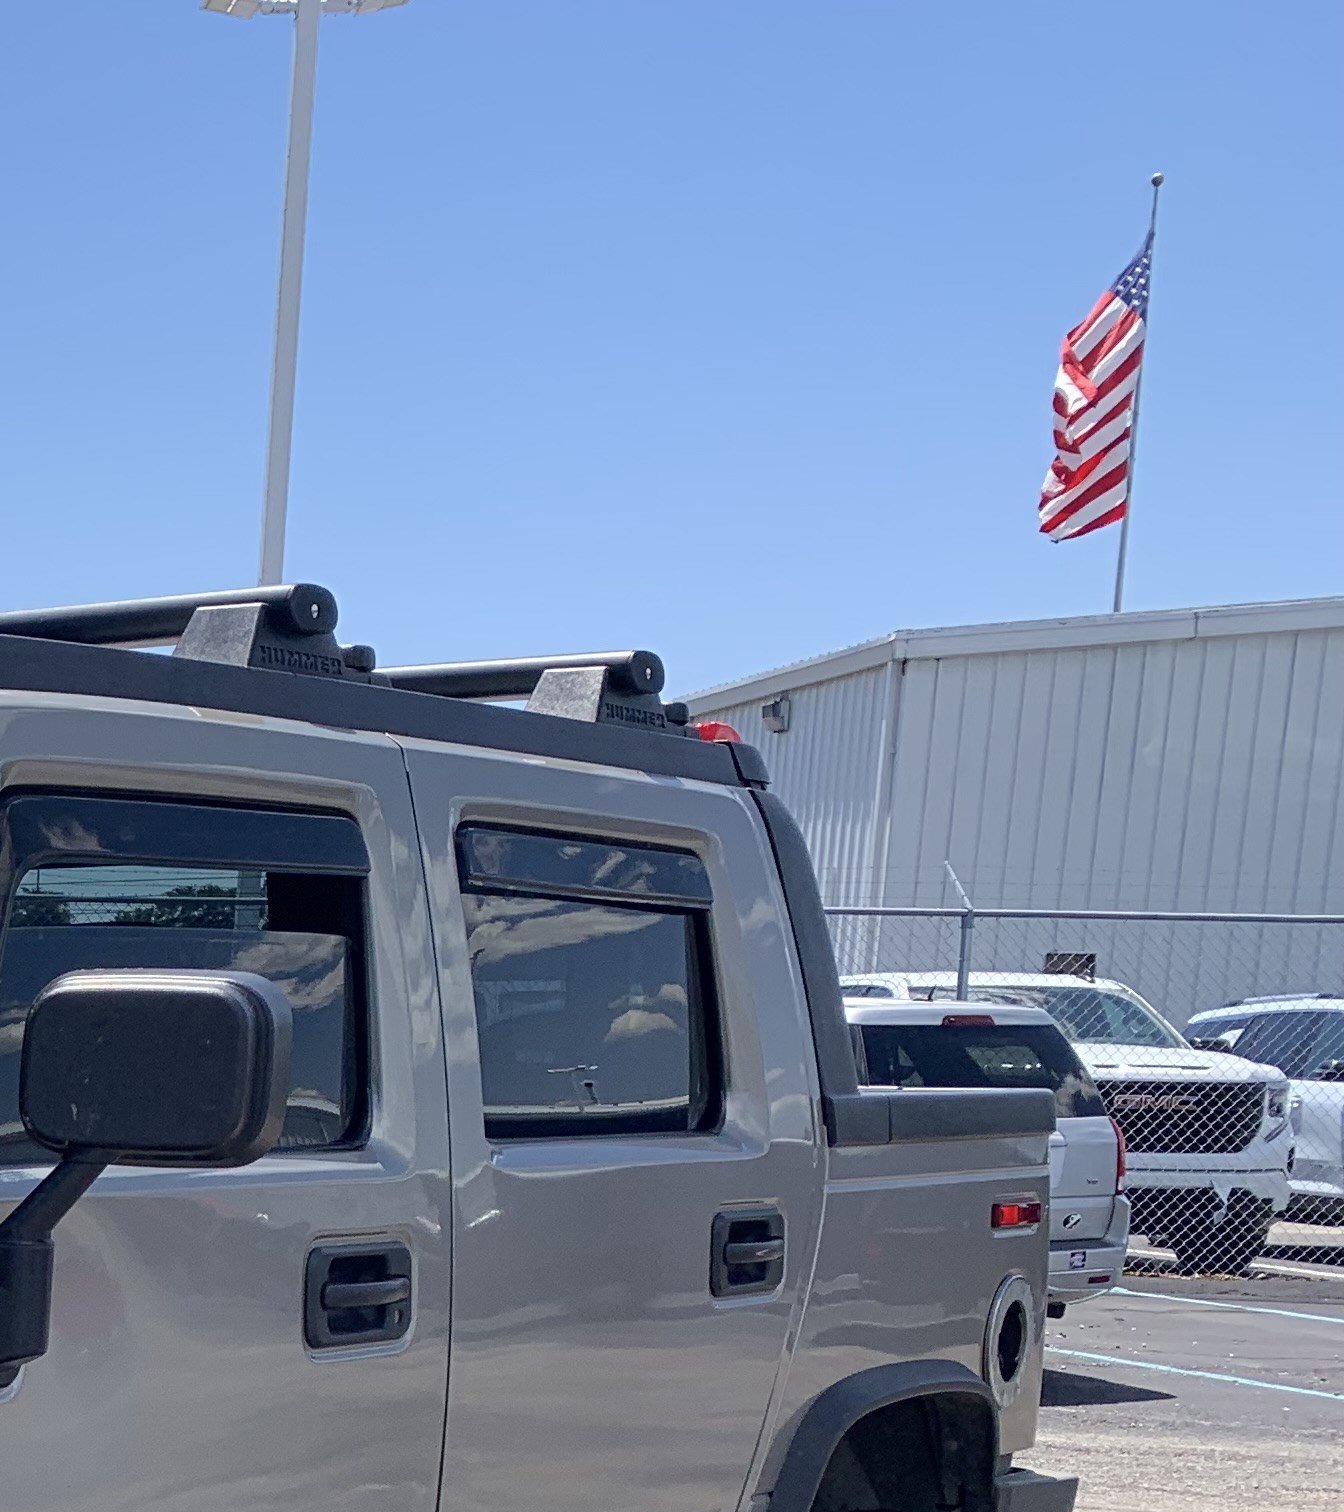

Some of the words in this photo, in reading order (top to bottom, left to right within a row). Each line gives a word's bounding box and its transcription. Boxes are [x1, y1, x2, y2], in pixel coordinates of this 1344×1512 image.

[259, 645, 343, 675] HUMMER
[605, 702, 667, 729] HUMMER
[1114, 1095, 1198, 1111] GMC
